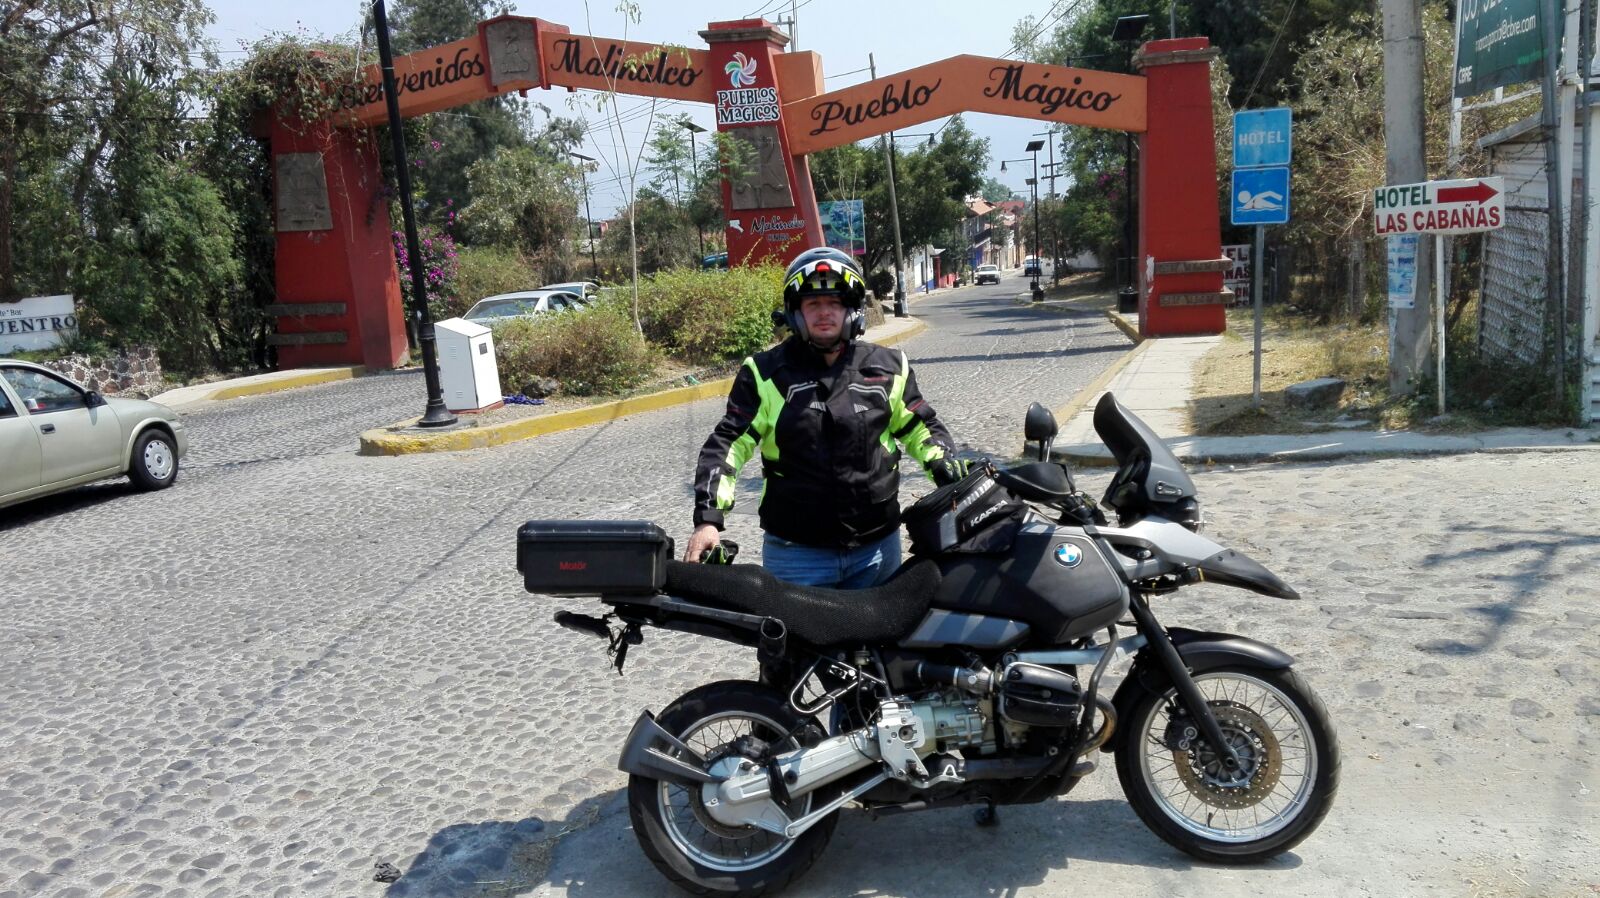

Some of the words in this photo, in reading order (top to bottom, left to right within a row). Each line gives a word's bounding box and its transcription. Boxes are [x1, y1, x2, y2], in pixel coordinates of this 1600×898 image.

[551, 38, 703, 87] Malinalco
[810, 78, 941, 136] Pueblo
[984, 64, 1122, 115] Mágico
[1238, 130, 1285, 146] HOTEL
[1375, 185, 1432, 209] HOTEL
[1375, 212, 1408, 234] LAS
[1413, 203, 1500, 231] CABAÑAS
[970, 500, 1009, 527] KAPPA
